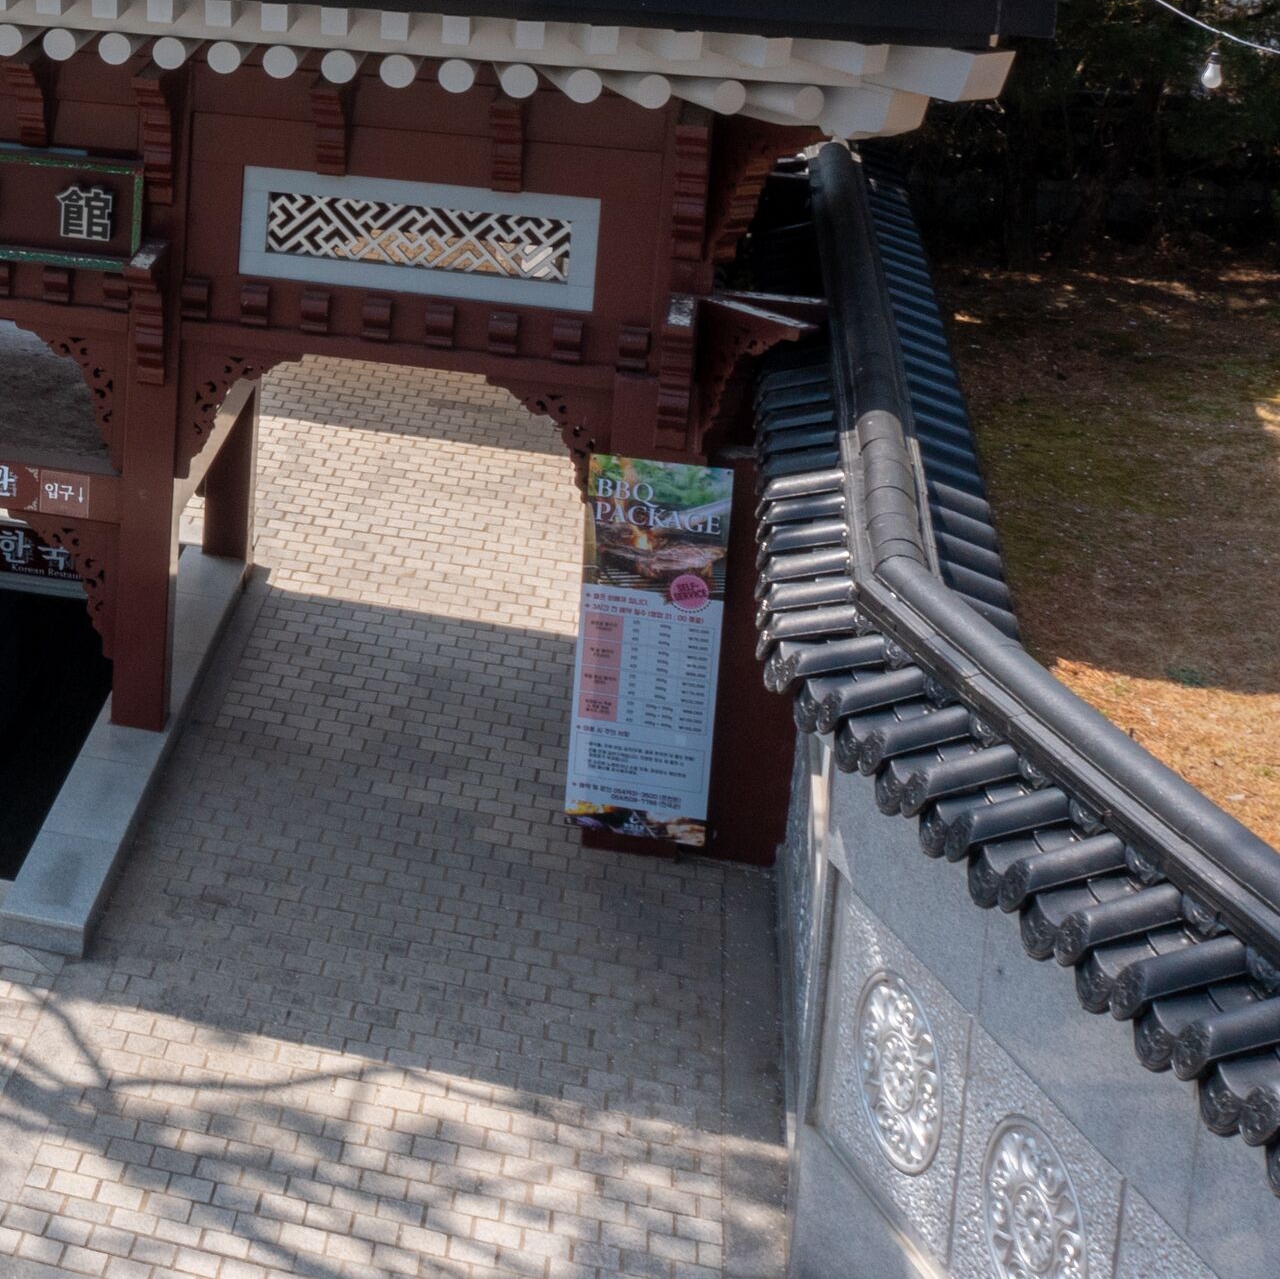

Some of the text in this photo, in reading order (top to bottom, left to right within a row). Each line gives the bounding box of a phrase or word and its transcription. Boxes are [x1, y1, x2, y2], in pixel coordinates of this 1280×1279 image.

[44, 483, 75, 501] 입구
[597, 477, 659, 508] BBQ
[596, 501, 721, 535] PACKAGE
[11, 564, 45, 575] Korean
